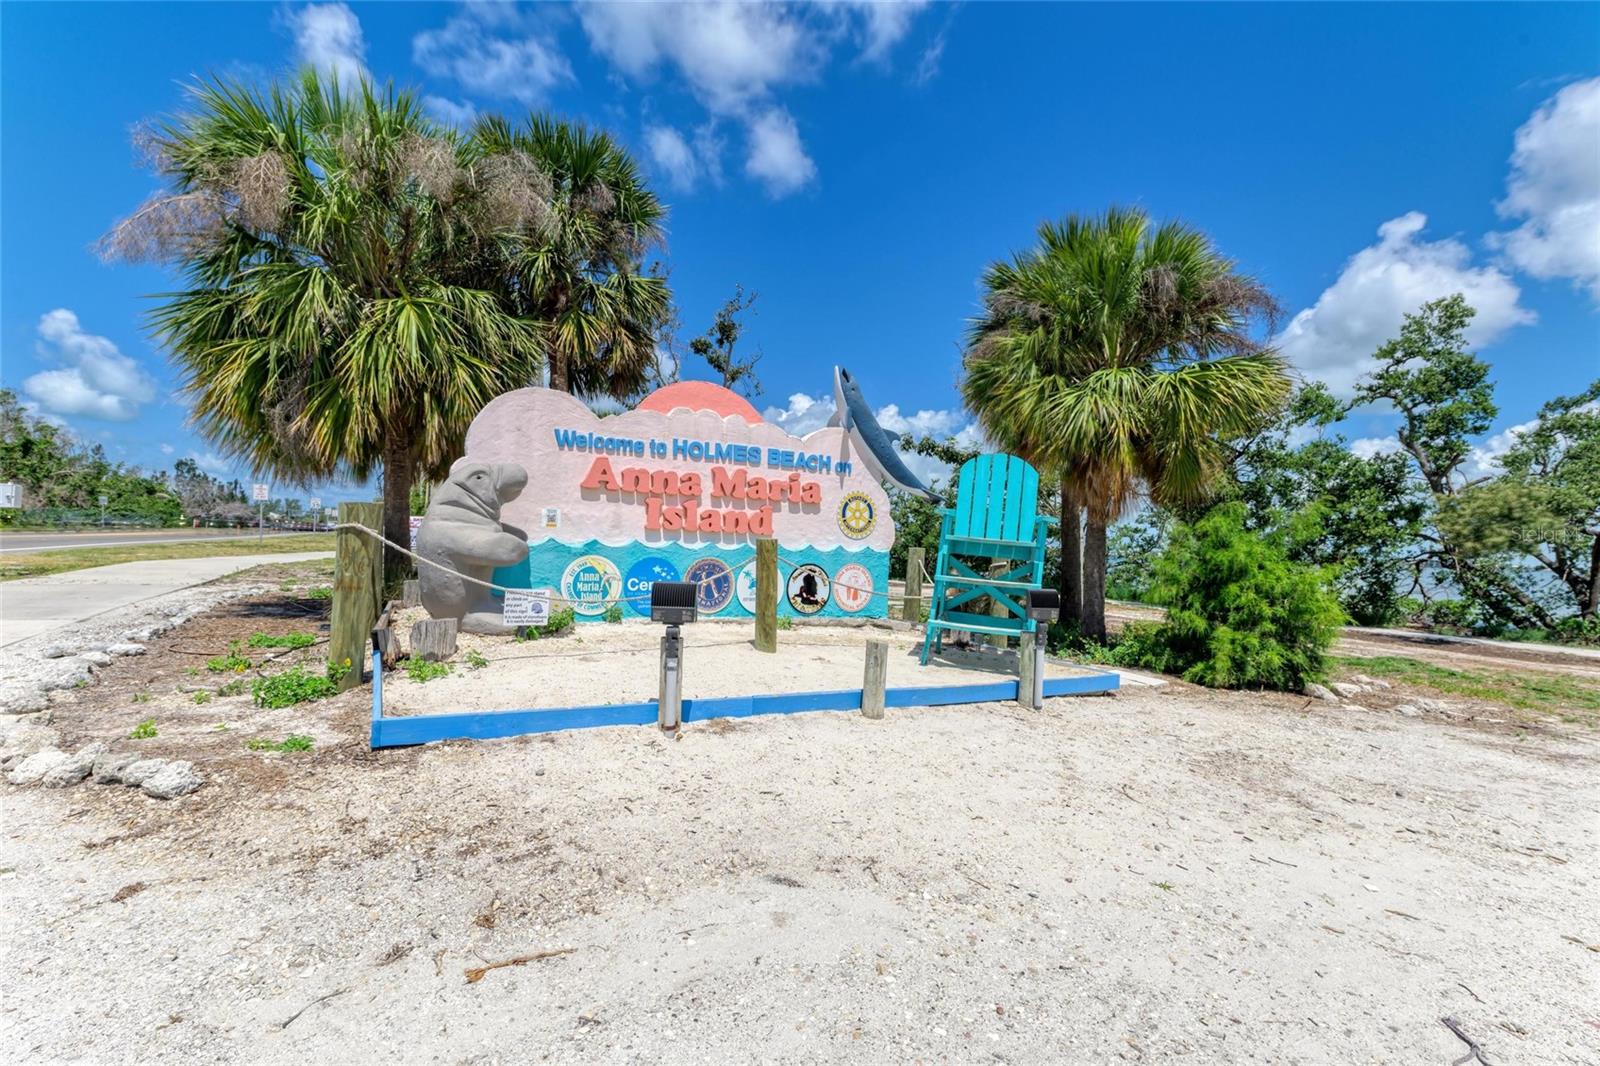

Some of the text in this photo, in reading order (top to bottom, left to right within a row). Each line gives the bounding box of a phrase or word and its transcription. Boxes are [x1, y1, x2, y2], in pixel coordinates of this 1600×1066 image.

[554, 428, 852, 477] Welcome to HOLMES BEACH on
[580, 456, 822, 504] Anna Maria
[644, 497, 774, 536] Island
[576, 582, 600, 592] Maria
[579, 572, 600, 581] Anna
[580, 592, 603, 601] Island
